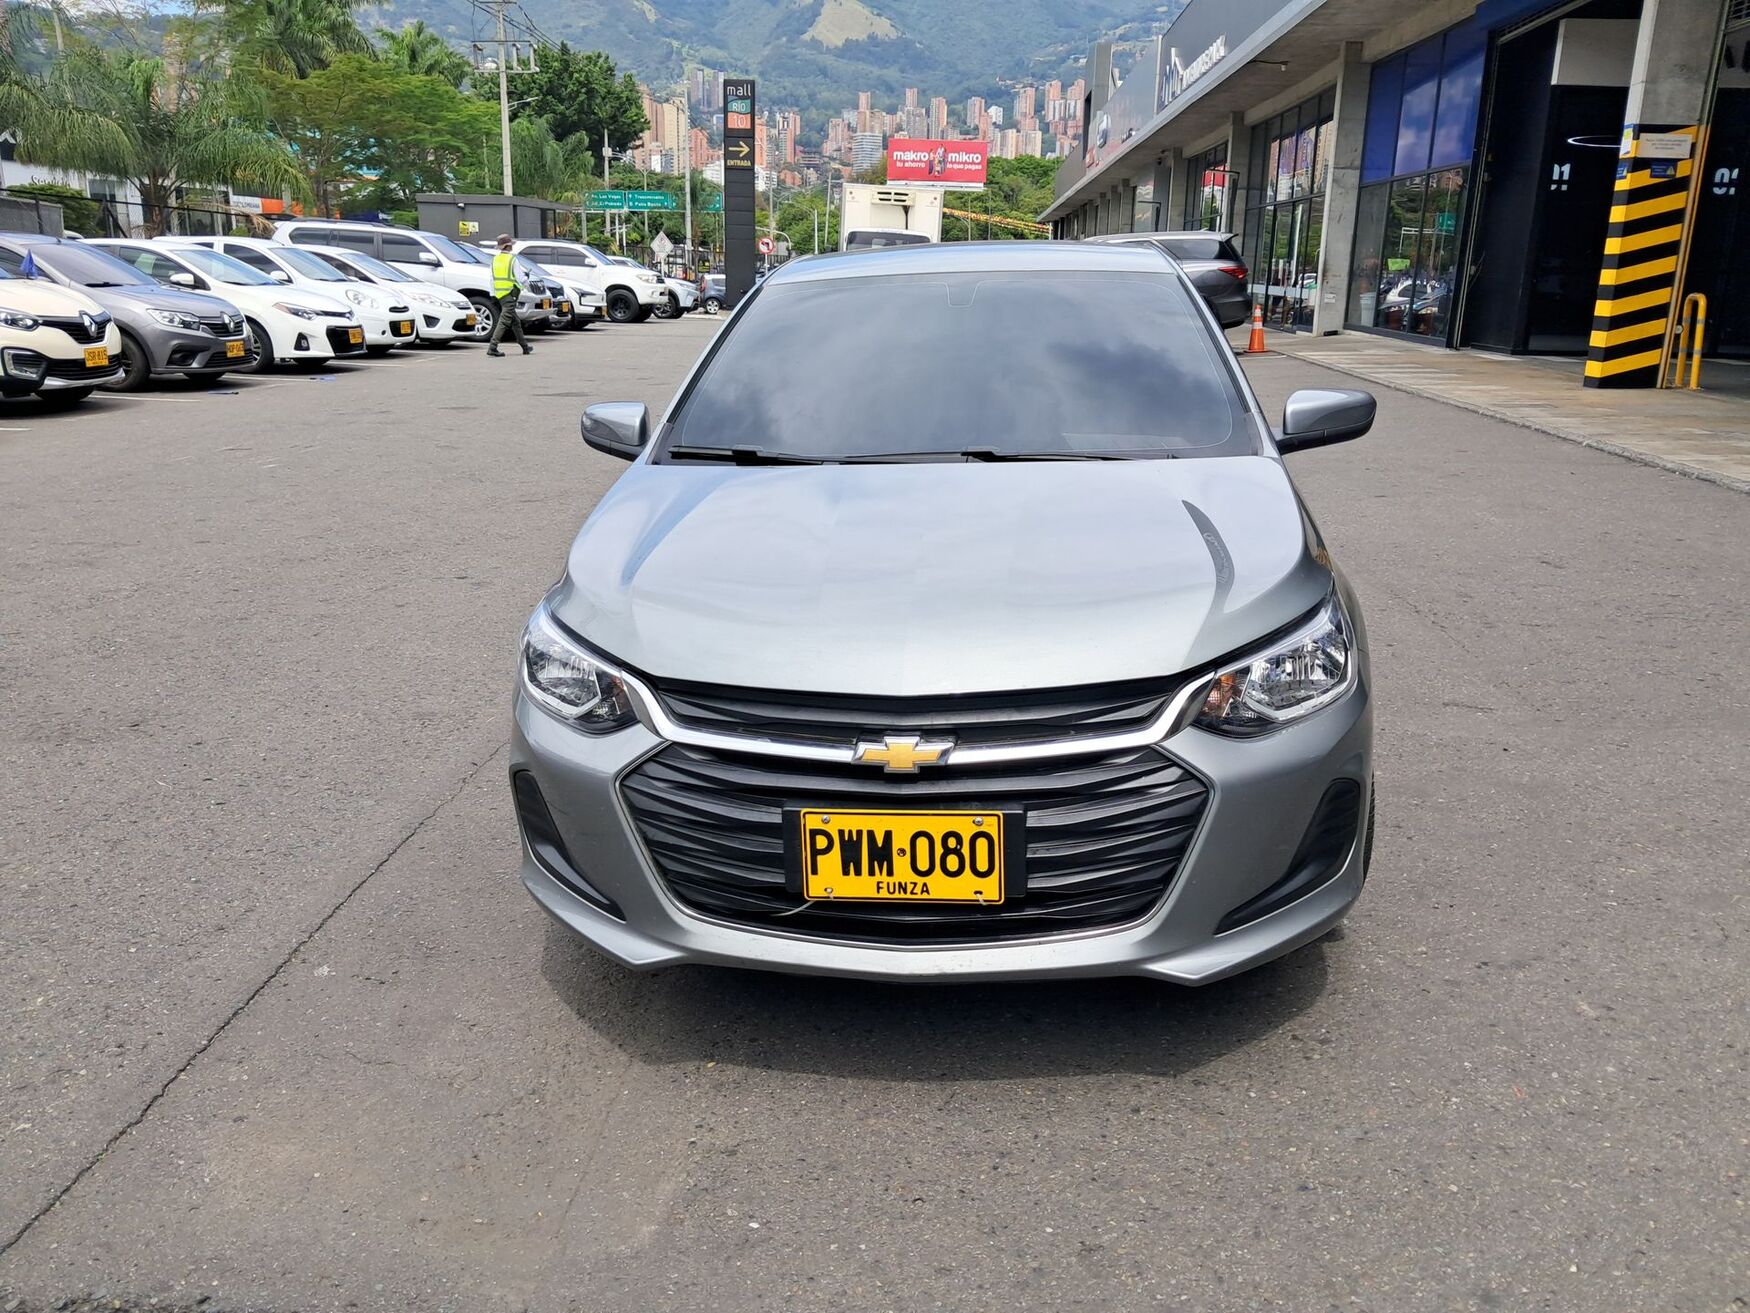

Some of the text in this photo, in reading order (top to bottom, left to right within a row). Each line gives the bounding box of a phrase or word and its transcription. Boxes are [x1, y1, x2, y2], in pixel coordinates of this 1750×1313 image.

[727, 83, 752, 96] mall
[732, 115, 746, 128] 10
[893, 150, 929, 161] makro
[948, 152, 982, 163] mikro
[727, 159, 752, 167] ENTRADA
[875, 880, 931, 895] FUNZA
